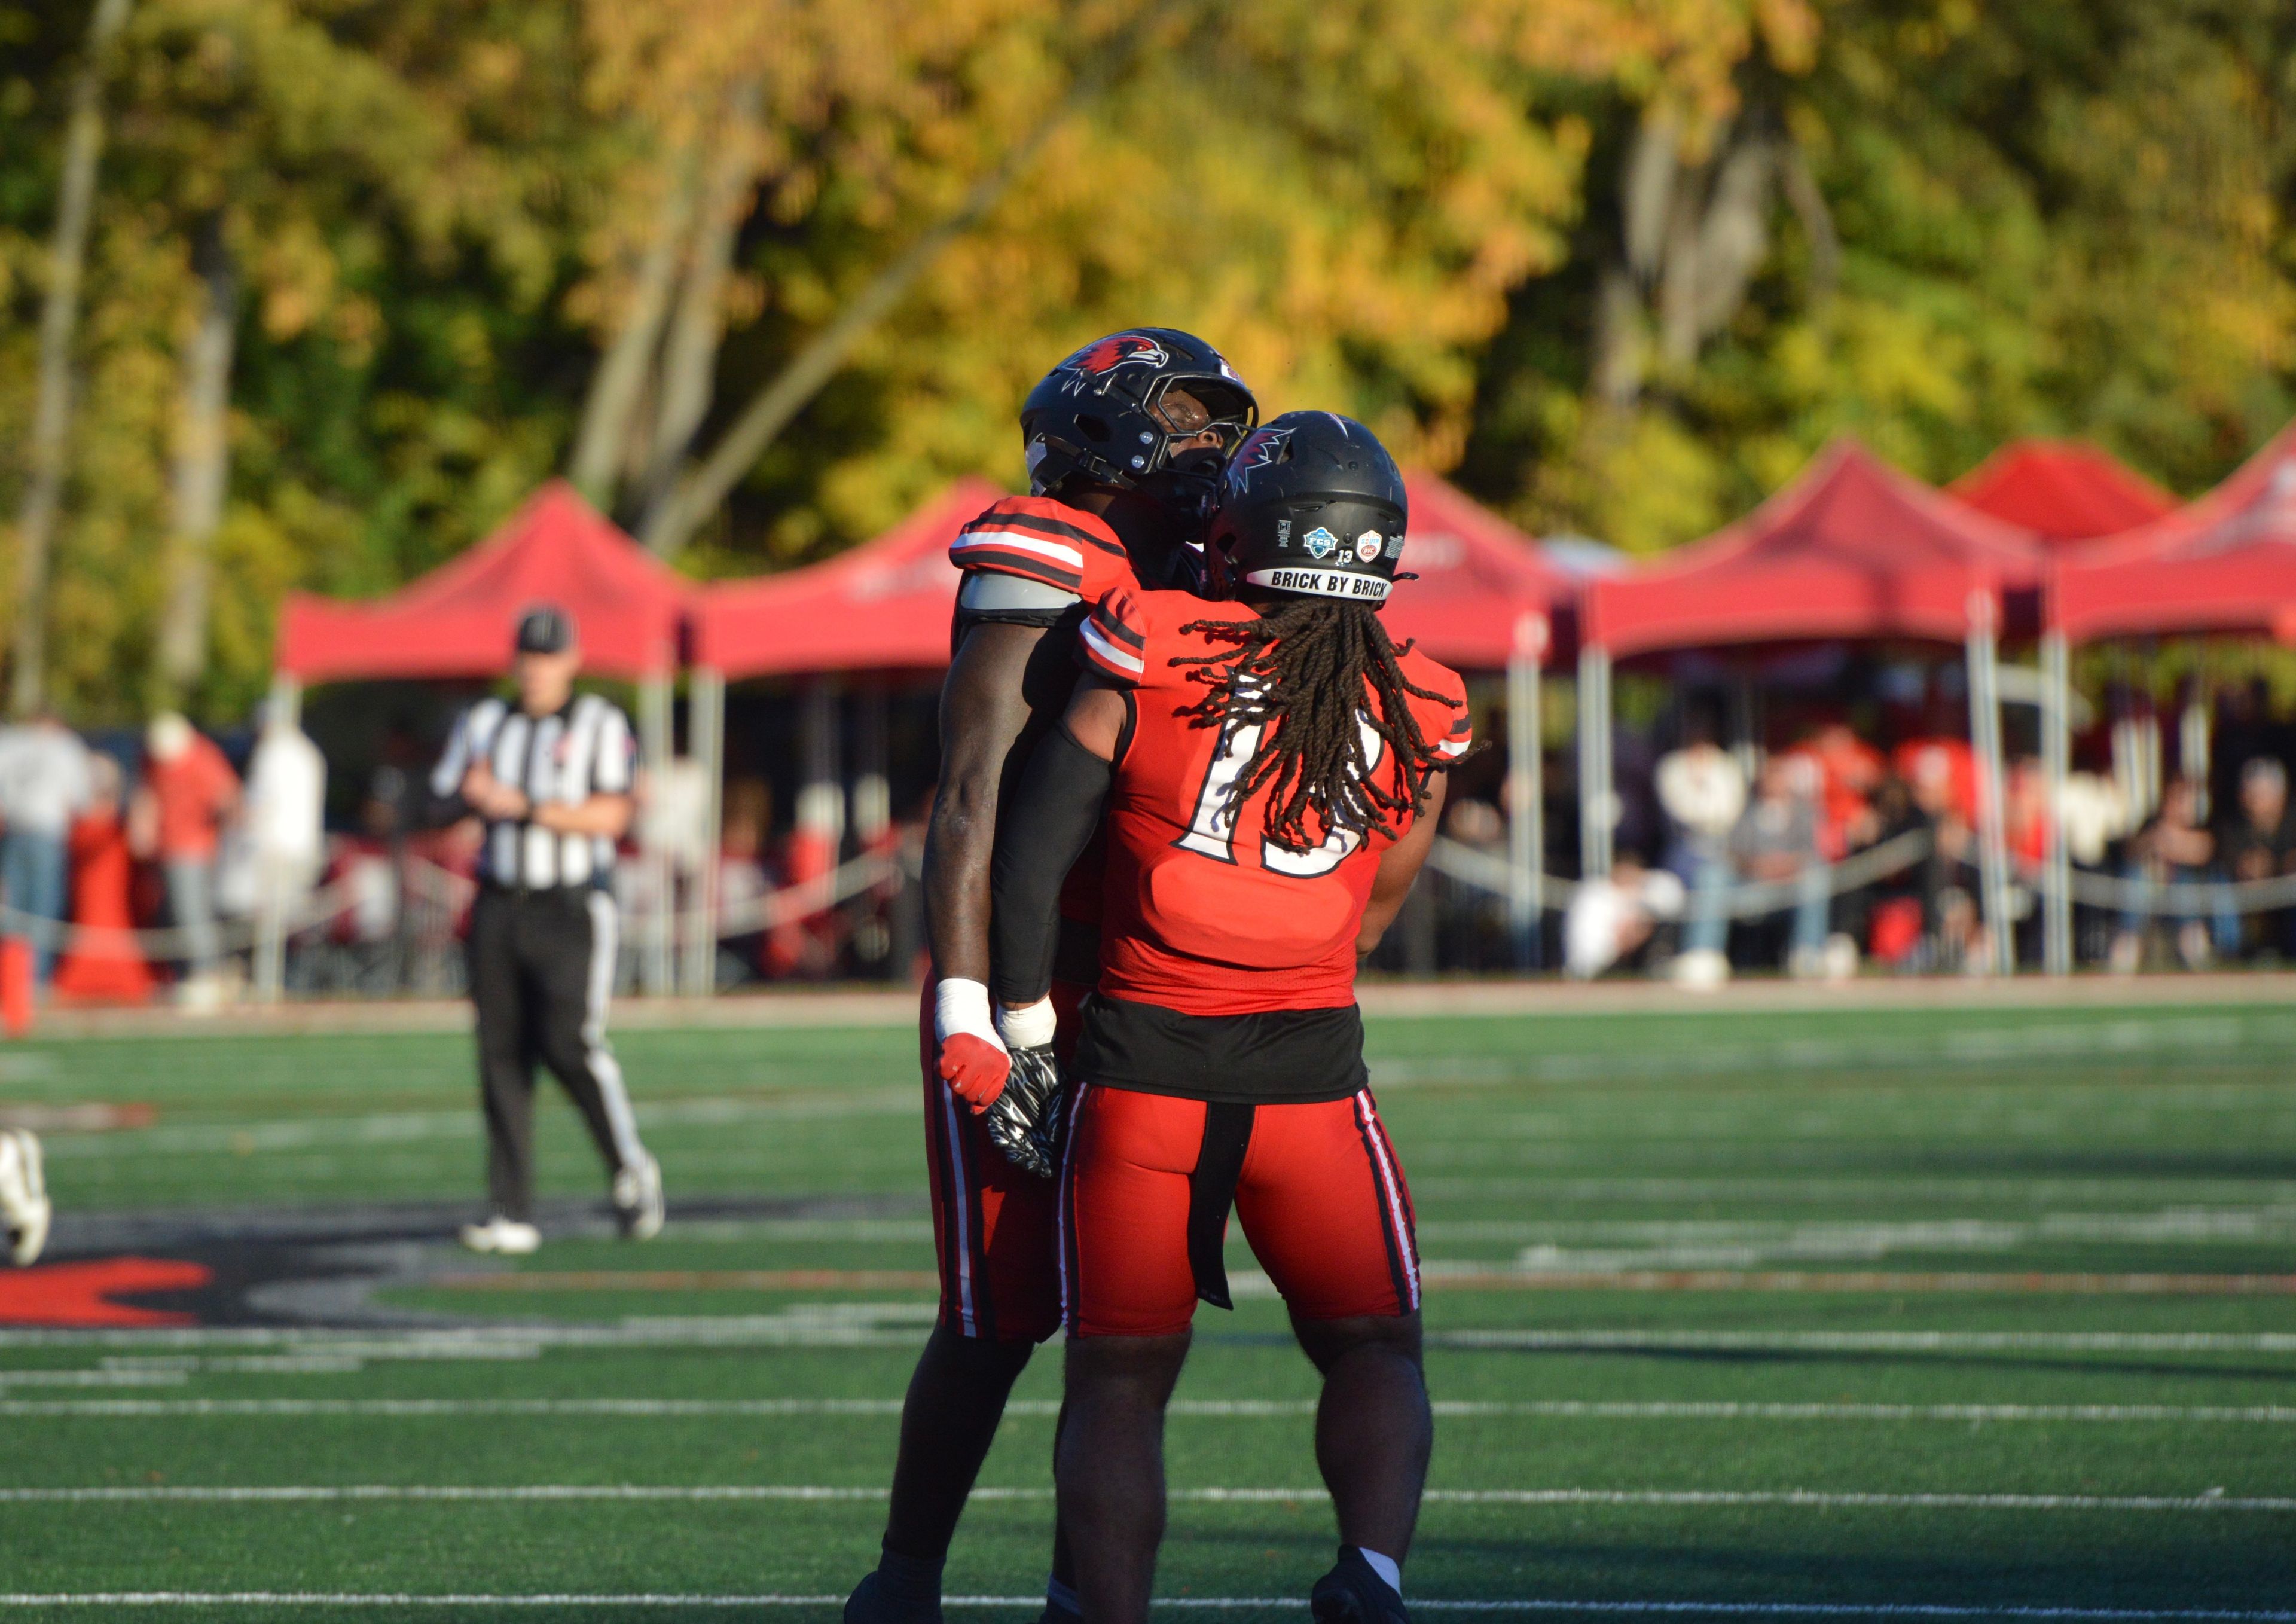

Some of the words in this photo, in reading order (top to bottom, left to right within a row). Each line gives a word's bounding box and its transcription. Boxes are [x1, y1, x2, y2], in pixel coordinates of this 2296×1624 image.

[1338, 550, 1353, 563] 13
[1271, 571, 1322, 590] BRICK
[1327, 575, 1349, 593] BY
[1352, 578, 1388, 597] BRICK
